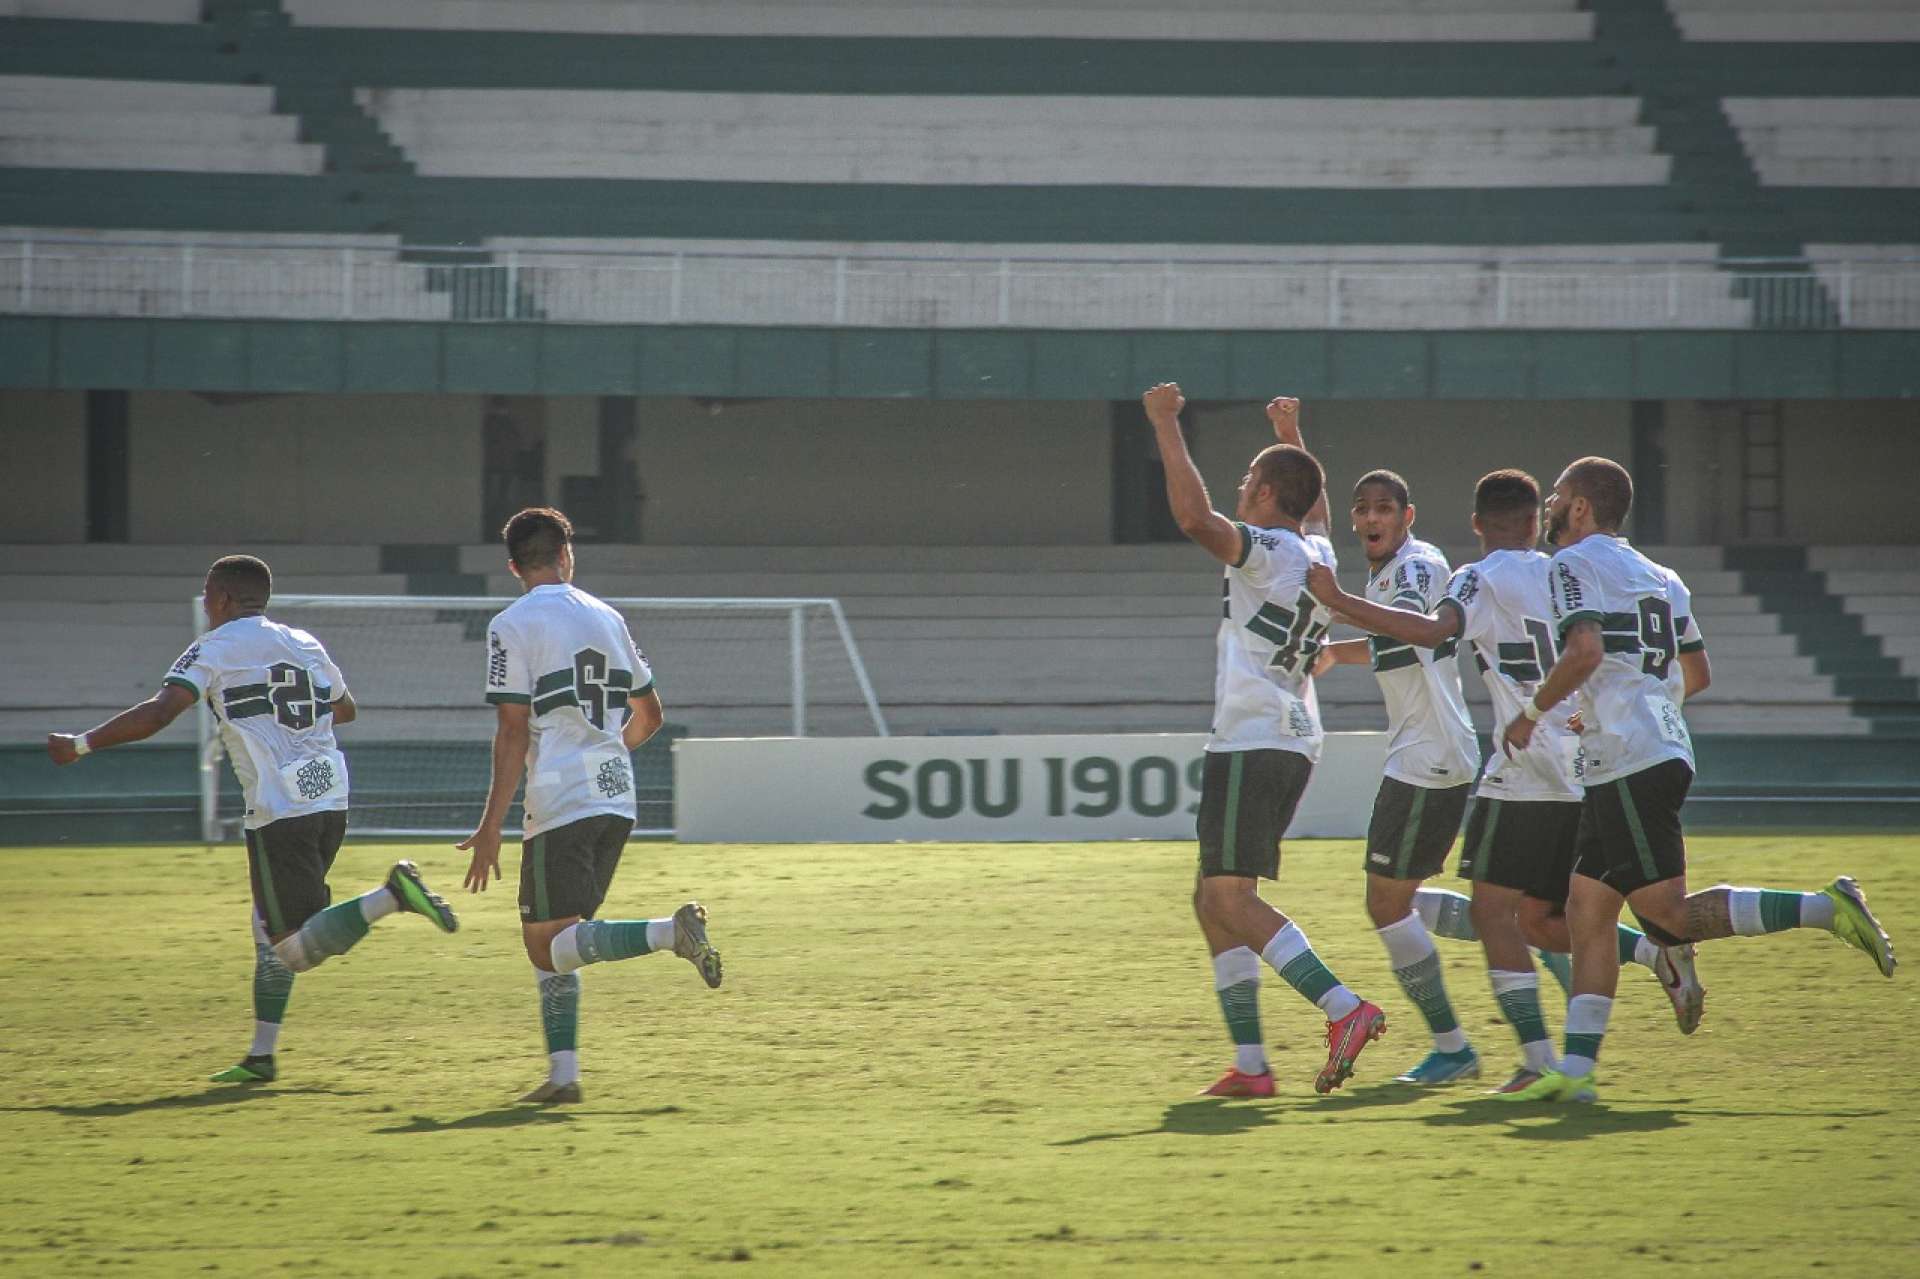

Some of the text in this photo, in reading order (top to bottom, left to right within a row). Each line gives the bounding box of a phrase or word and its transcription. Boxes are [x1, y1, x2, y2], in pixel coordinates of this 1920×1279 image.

[1638, 596, 1674, 681] 9
[267, 662, 315, 731] 2
[574, 648, 606, 731] 5
[861, 758, 1022, 820] SOU
